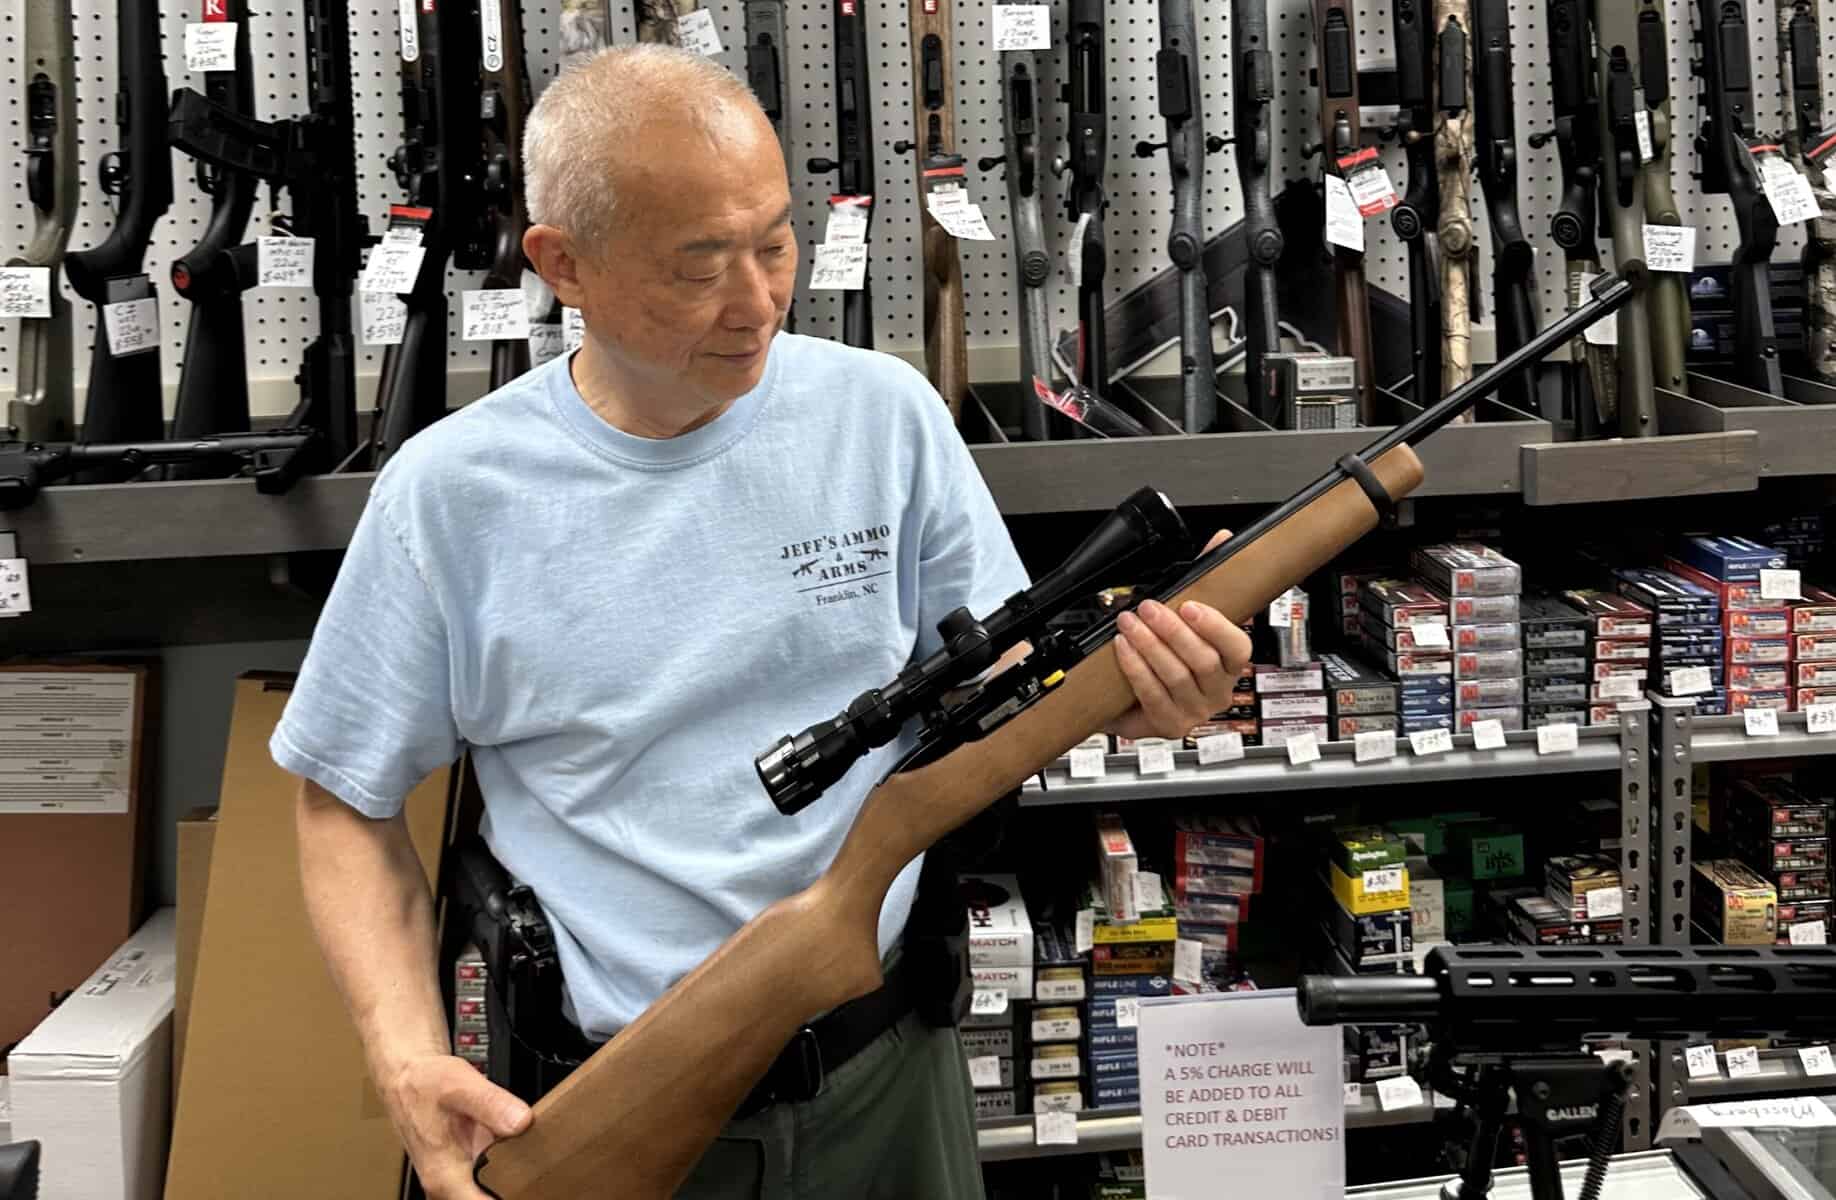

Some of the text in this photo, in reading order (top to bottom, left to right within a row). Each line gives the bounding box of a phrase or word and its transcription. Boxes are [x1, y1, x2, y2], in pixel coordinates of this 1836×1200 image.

[781, 525, 890, 559] JEFF'S AMMO
[819, 561, 867, 581] ARMS
[816, 583, 879, 606] Franklin, NC
[1164, 1061, 1314, 1081] A 5% CHARGE WILL
[1165, 1084, 1303, 1104] BE ADDED TO ALL
[1165, 1107, 1288, 1126] CREDIT & DEBIT
[1165, 1127, 1340, 1149] CARD TRANSACTIONS!
